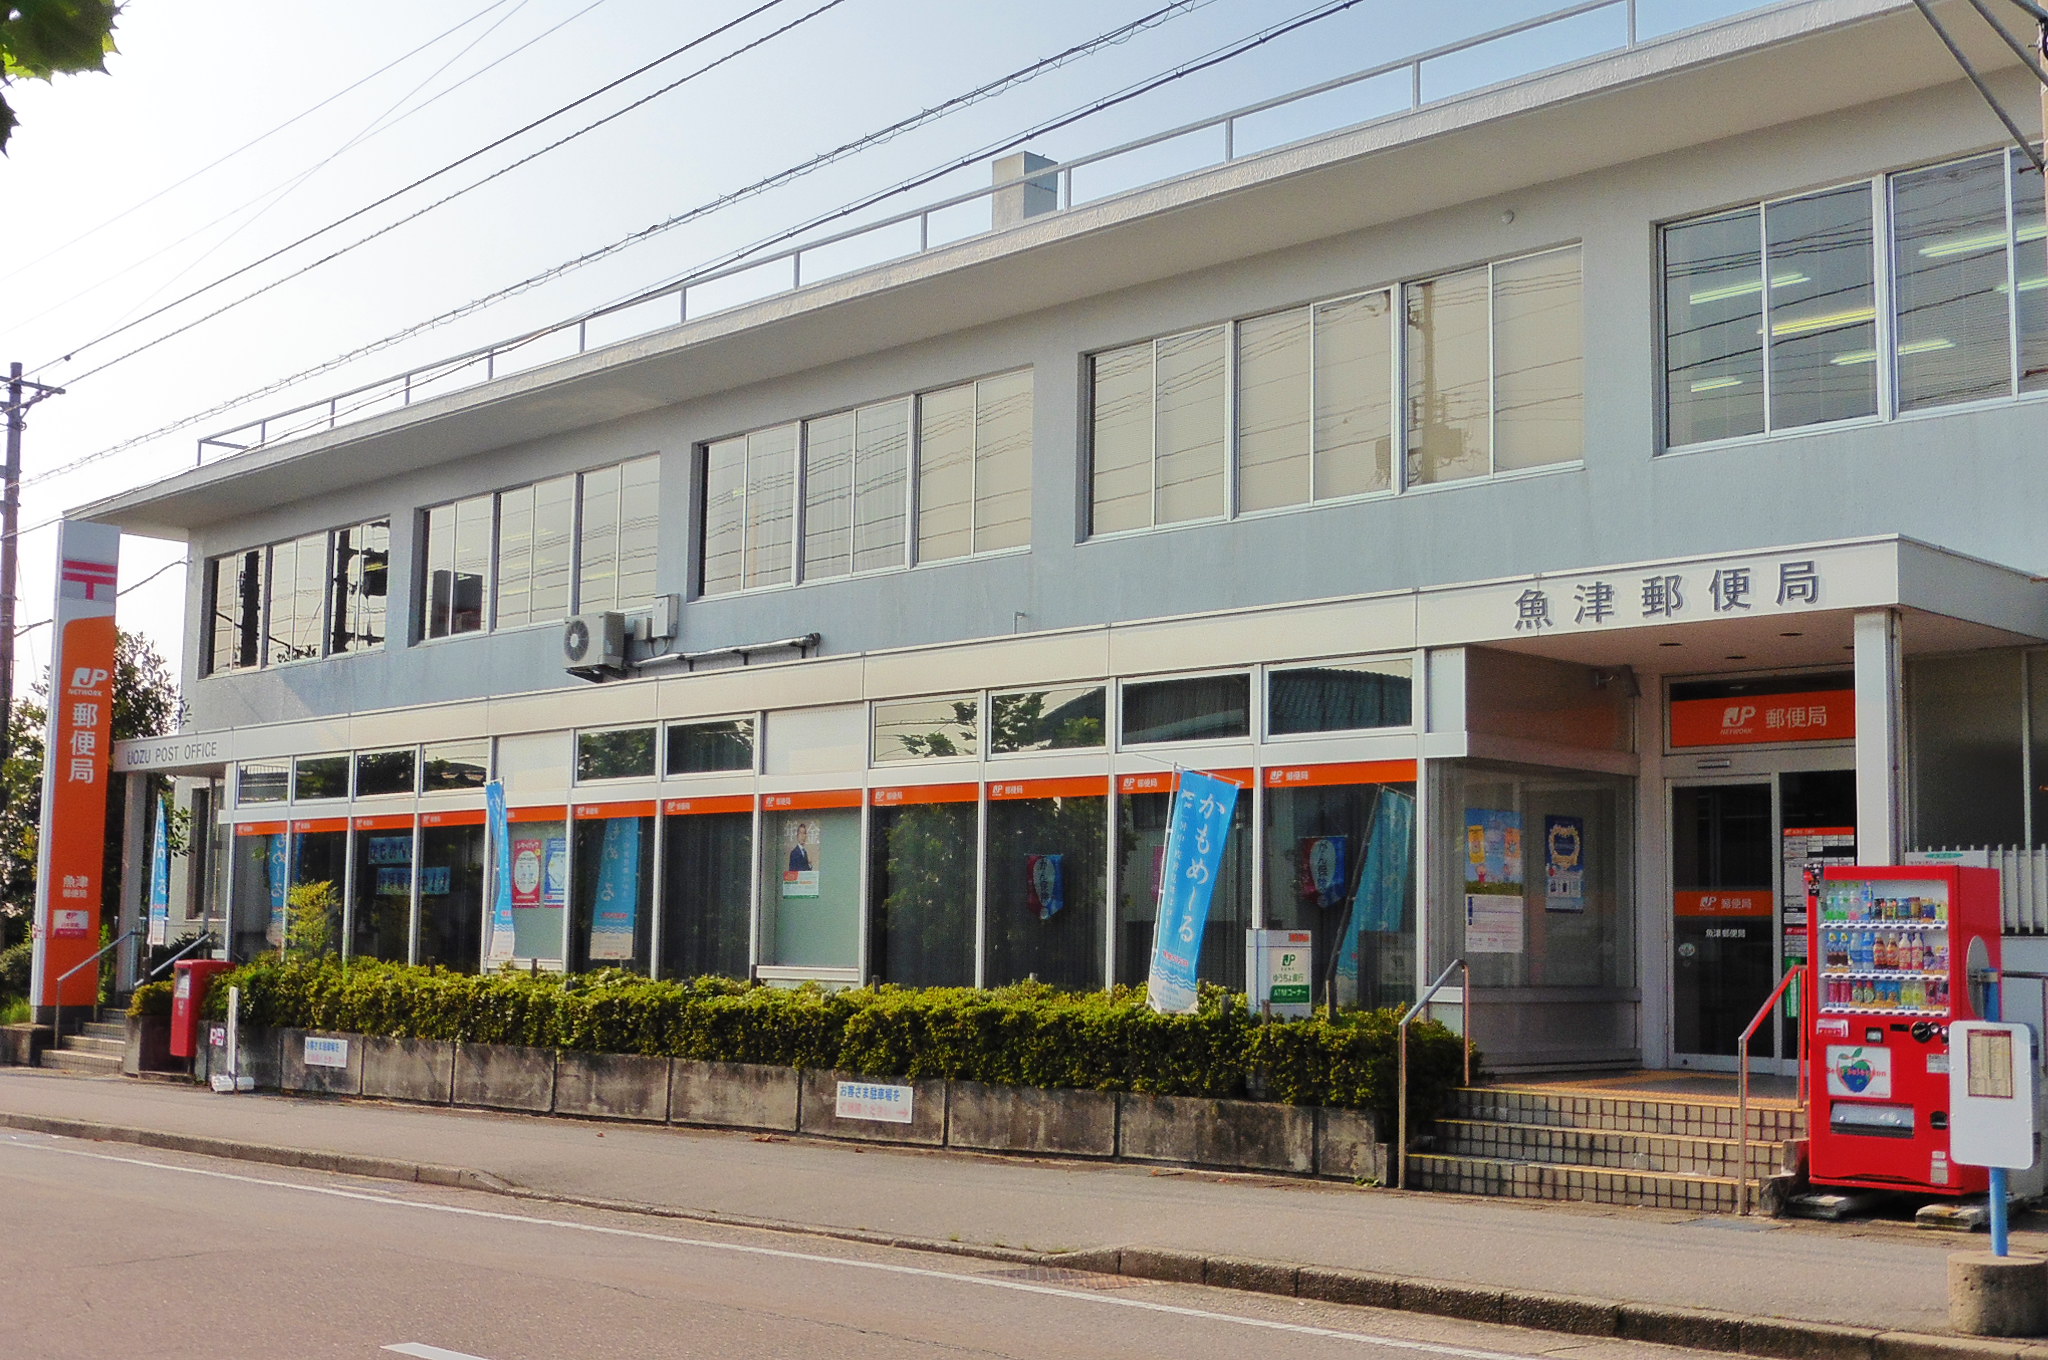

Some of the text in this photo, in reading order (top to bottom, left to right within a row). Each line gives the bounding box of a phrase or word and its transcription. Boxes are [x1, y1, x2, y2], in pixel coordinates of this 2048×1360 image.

[1514, 560, 1820, 631] 魚津郵便局
[71, 667, 108, 688] JP
[68, 688, 103, 696] NETWORK
[1722, 706, 1828, 729] JP 郵便局
[1720, 728, 1755, 736] NETWORK
[68, 702, 99, 784] 郵便局
[127, 742, 218, 766] UOZU POST OFFICE
[1721, 898, 1752, 909] 郵便局
[1705, 928, 1746, 938] 魚津郵便局
[1282, 954, 1296, 966] JP
[1272, 973, 1304, 983] ゆうちょ銀行
[1273, 988, 1308, 997] ATMコーナー
